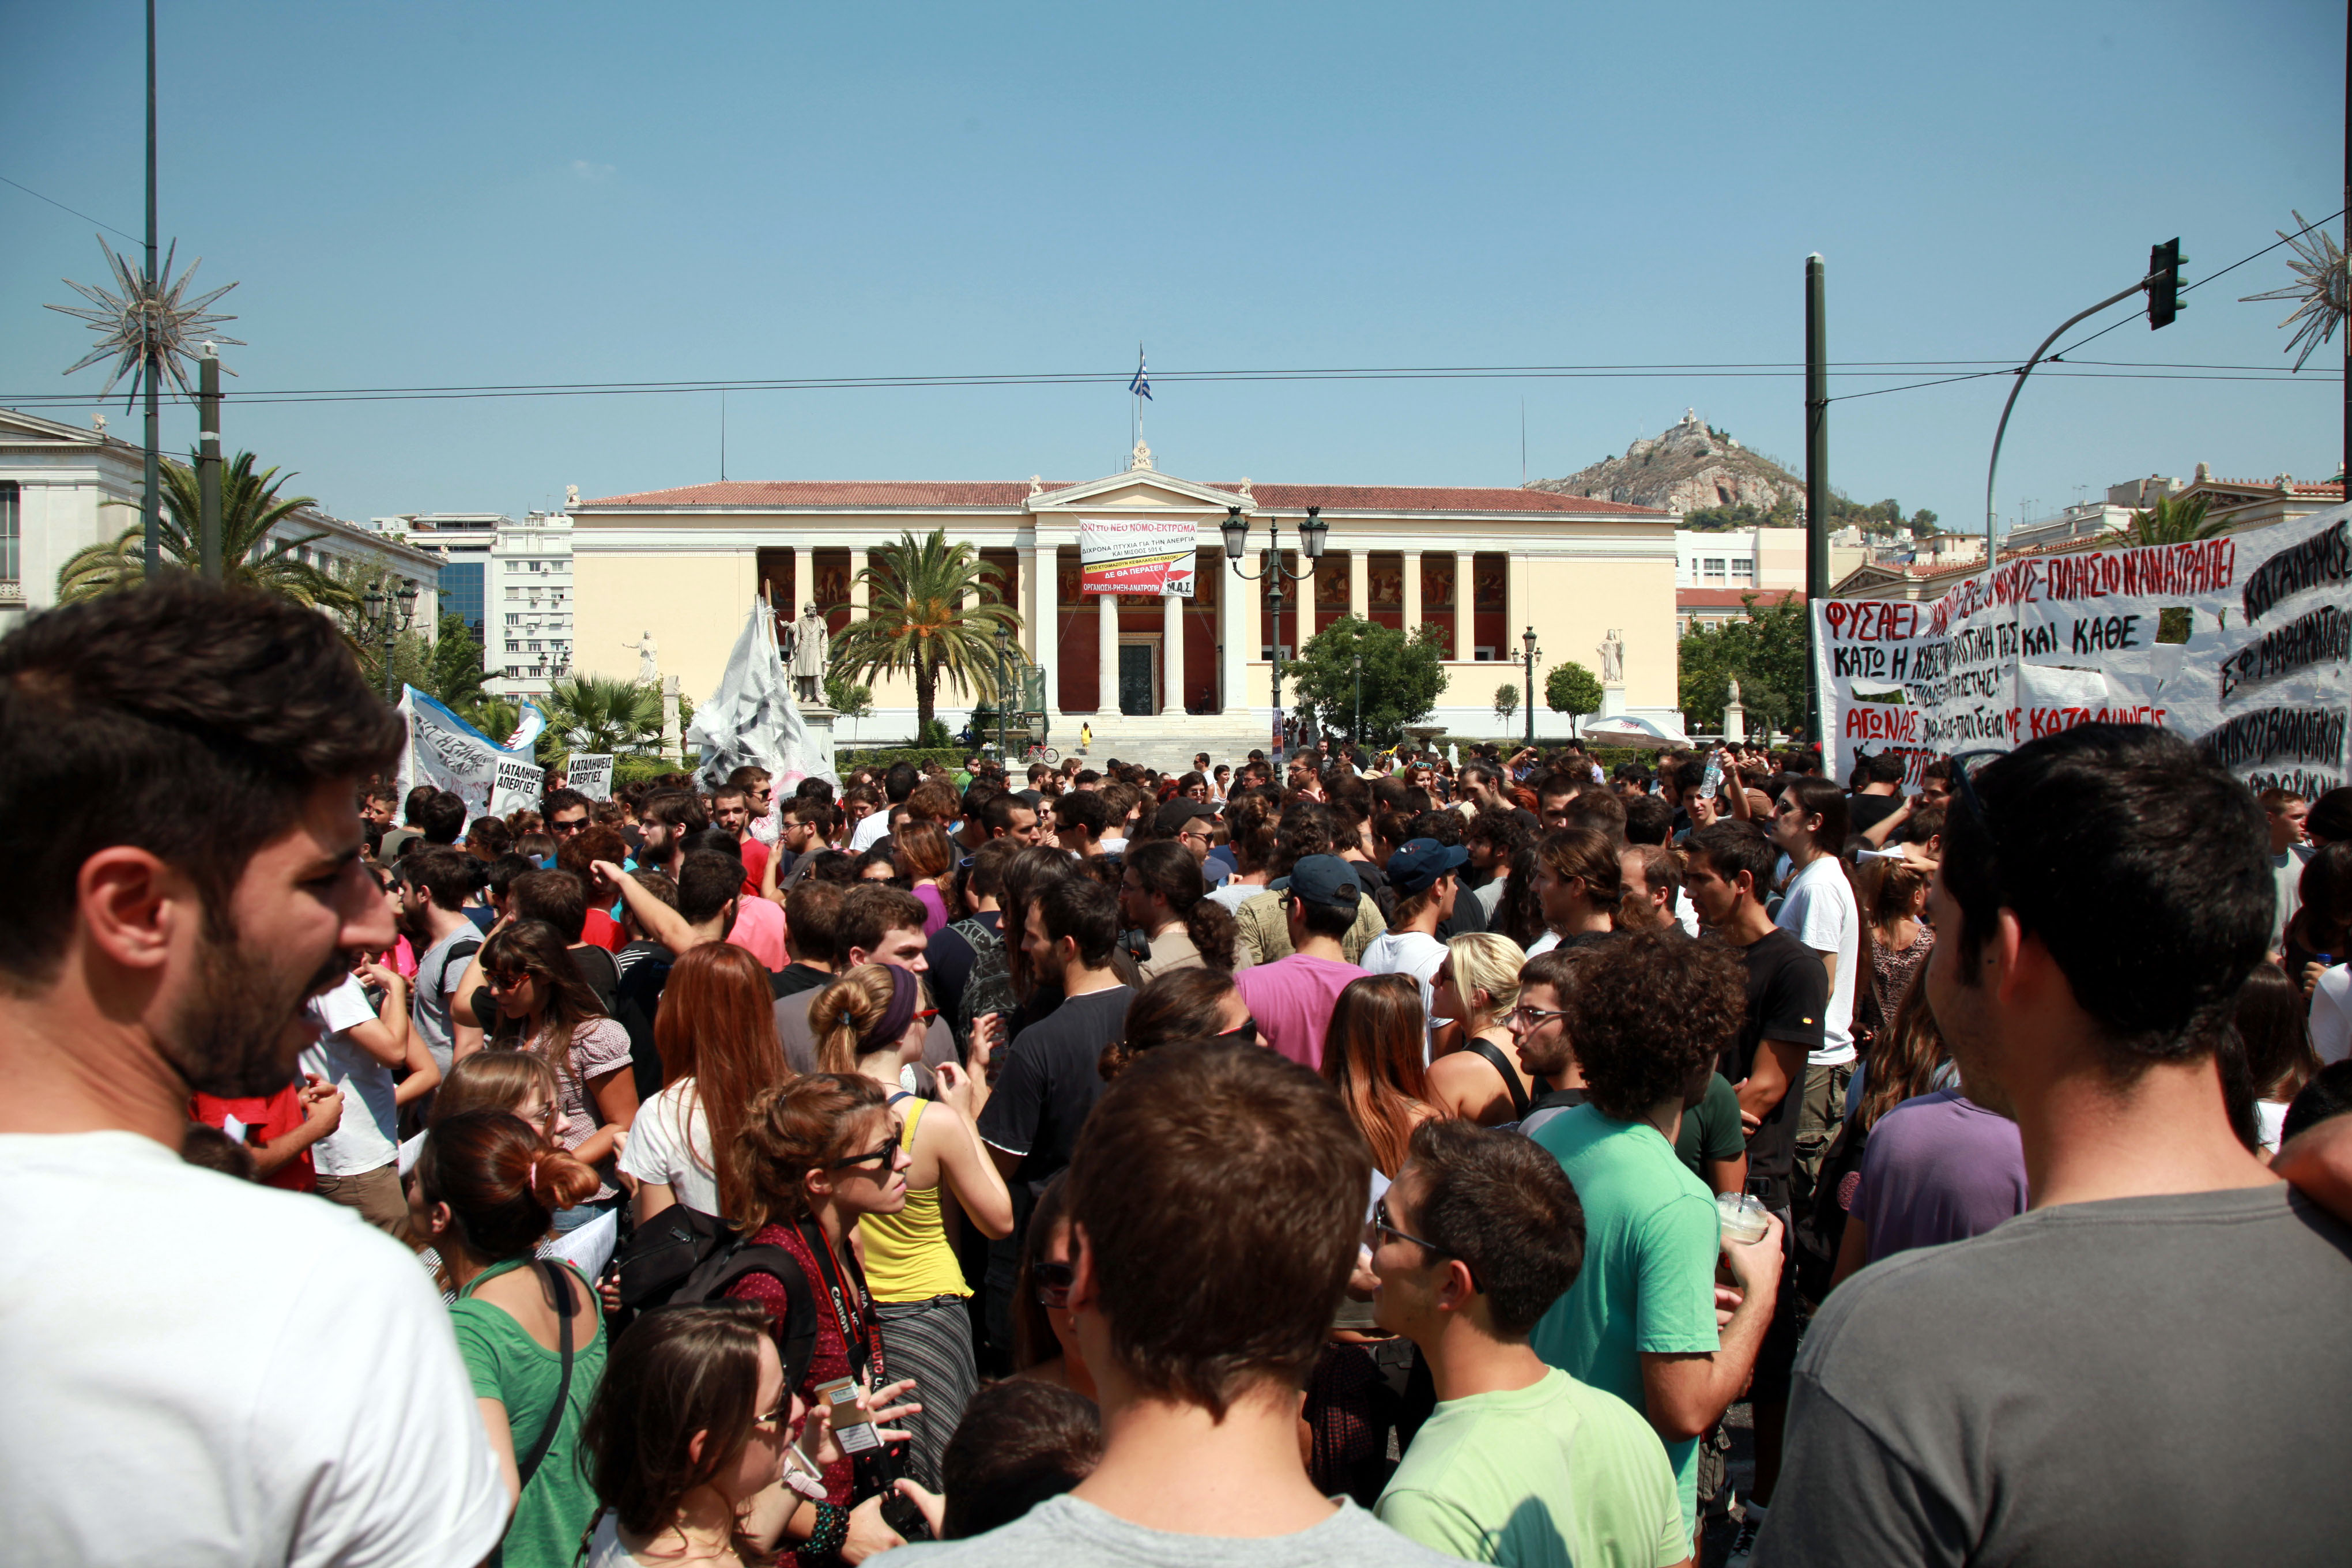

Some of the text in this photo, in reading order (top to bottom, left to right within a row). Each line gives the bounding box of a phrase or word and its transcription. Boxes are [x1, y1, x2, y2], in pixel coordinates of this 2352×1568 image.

[1081, 523, 1095, 531] ΟΧΙ
[1130, 523, 1196, 533] ΝΟΜΟ-ΕΚΤΡΩΜΑ
[1082, 545, 1111, 554] ΔΙΧΡΟΝΑ
[1113, 542, 1137, 551] ΠΤΥΧΙΑ
[1167, 536, 1195, 544] ΑΝΕΡΓΙΑ
[1083, 583, 1159, 593] ΟΡΓΑΝΩΣΗ-ΡΗΞΗ-ΑΝΑΤΡΟΠΗ
[1826, 602, 1918, 642] ΦΥΣΑΕΙ
[1834, 646, 1886, 679] ΚΑΤΩ
[1891, 646, 1909, 680] Η
[2022, 623, 2057, 657] ΚΑΙ
[2073, 615, 2141, 655] ΚΑΘΕ
[1846, 707, 1919, 743] ΑΓΩΝΑΣ
[2006, 707, 2023, 745] ΜΕ
[498, 762, 545, 783] ΚΑΤΑΛΗΨΕΙΣ
[570, 757, 612, 772] ΚΑΤΑΛΗΨΕΙΣ
[496, 776, 536, 794] ΑΠΕΡΓΙΕΣ
[568, 771, 602, 785] ΑΠΕΡΓΙΕΣ
[859, 1285, 868, 1309] USA
[831, 1286, 850, 1333] Canon
